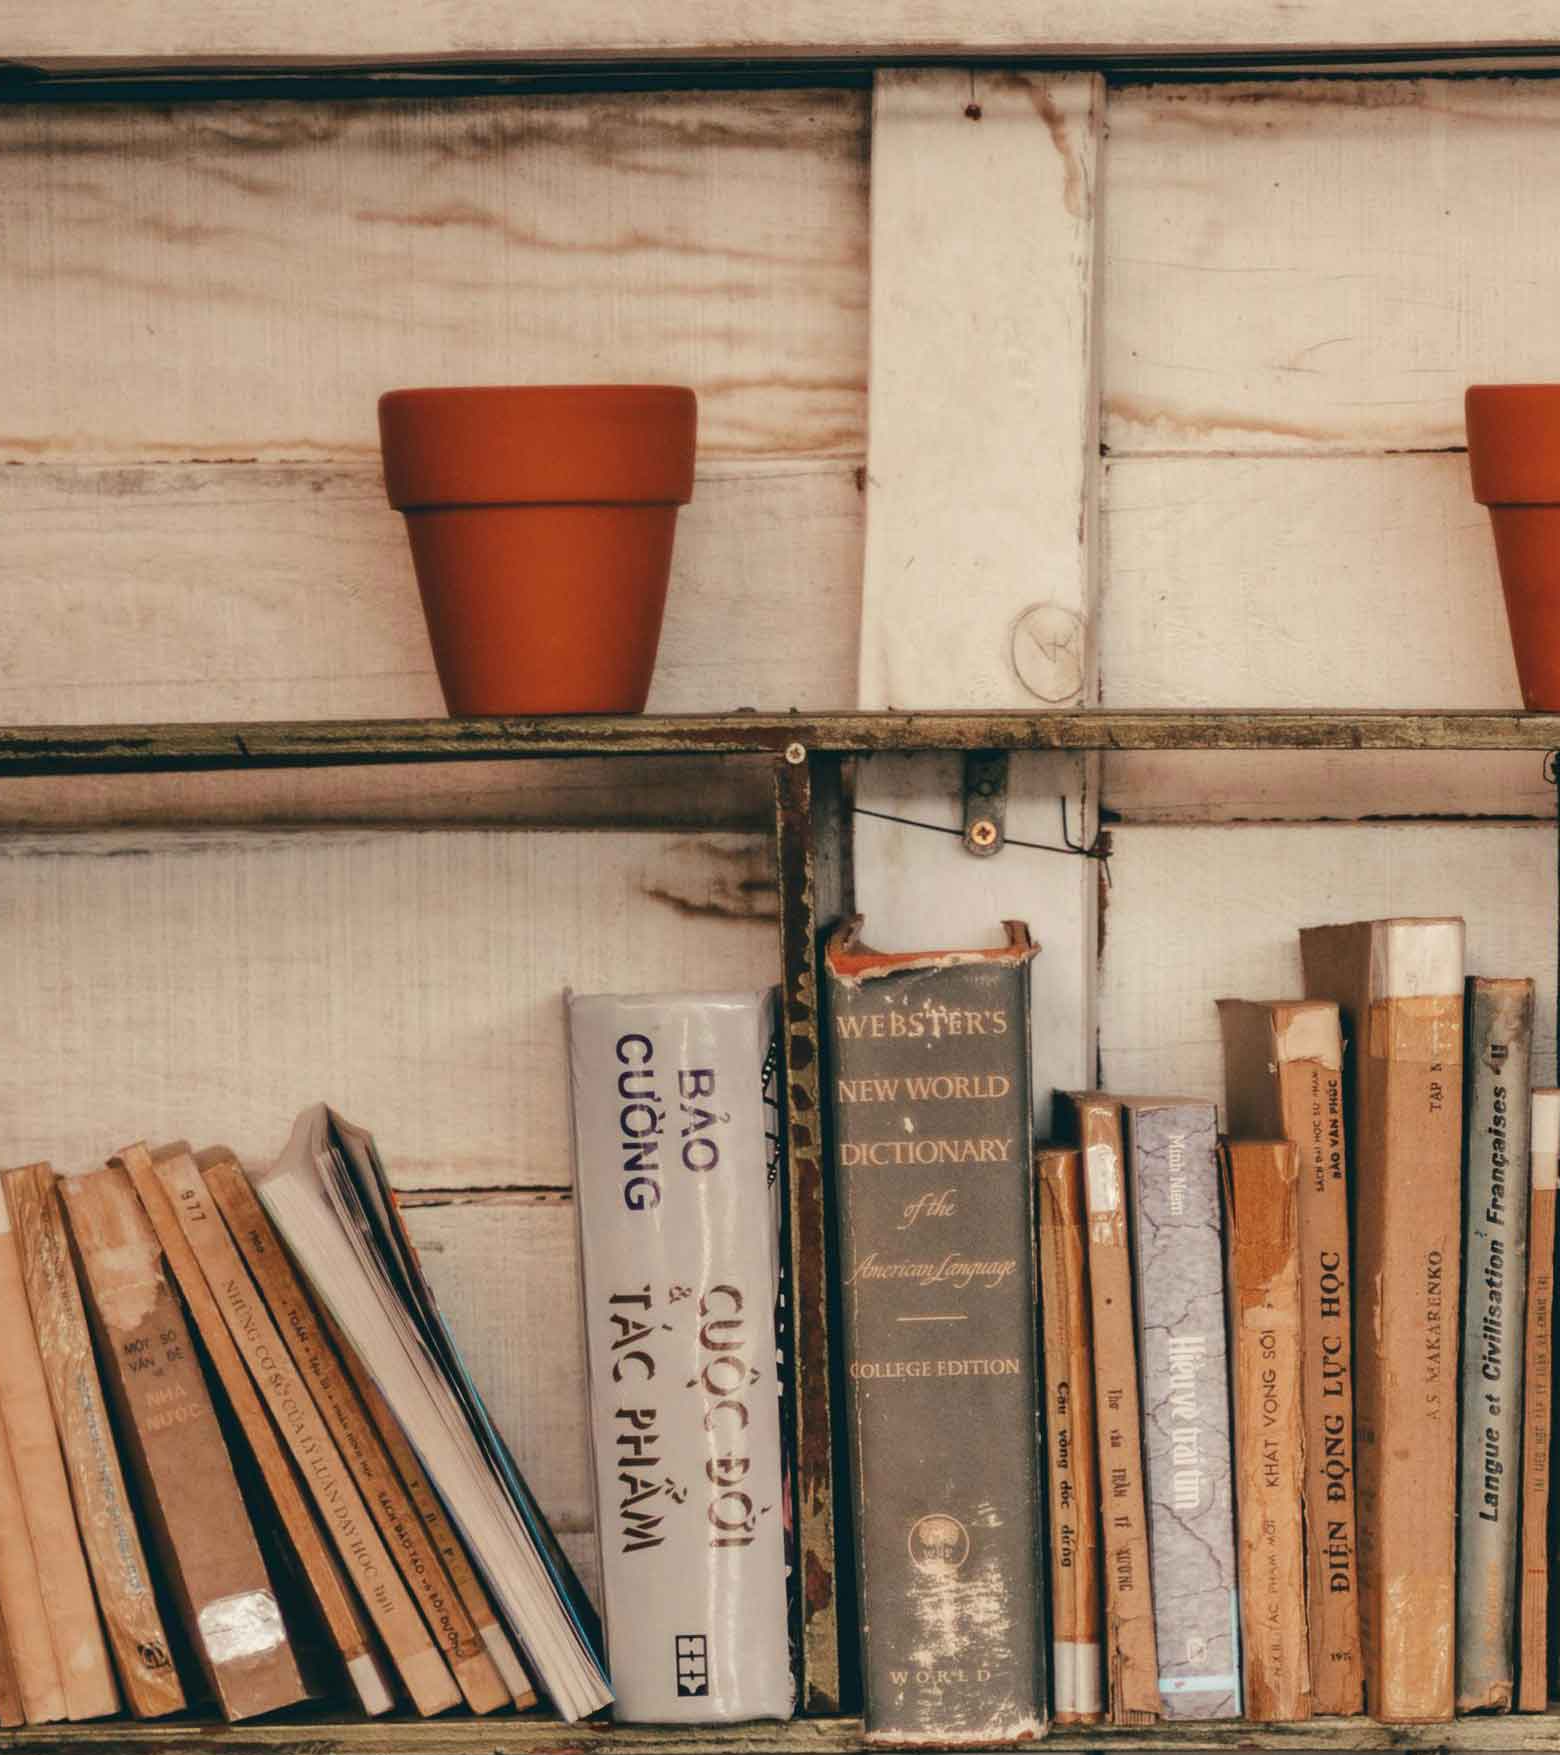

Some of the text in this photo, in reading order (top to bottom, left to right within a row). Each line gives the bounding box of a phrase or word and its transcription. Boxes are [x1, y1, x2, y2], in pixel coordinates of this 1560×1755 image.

[837, 1008, 1008, 1039] WEBSTER'S
[837, 1075, 1010, 1104] NEW WORLD
[615, 1033, 668, 1212] CƯỜNG
[676, 1068, 731, 1173] BẢO
[839, 1139, 1013, 1166] DICTIONARY
[1162, 1133, 1188, 1216] Minh Niệm
[895, 1191, 958, 1229] of the
[847, 1256, 1018, 1286] American Language
[1478, 1085, 1510, 1521] Langue et Civilisation Françaises
[850, 1357, 1019, 1378] COLLEGE EDITION
[608, 1284, 684, 1555] TÁC PHẨM
[679, 1283, 776, 1549] CUỘC ĐỜI
[1318, 1251, 1353, 1593] ĐIỆN ĐỘNG LỰC HỌC
[1258, 1437, 1279, 1487] KHÁT
[1170, 1468, 1206, 1510] tim
